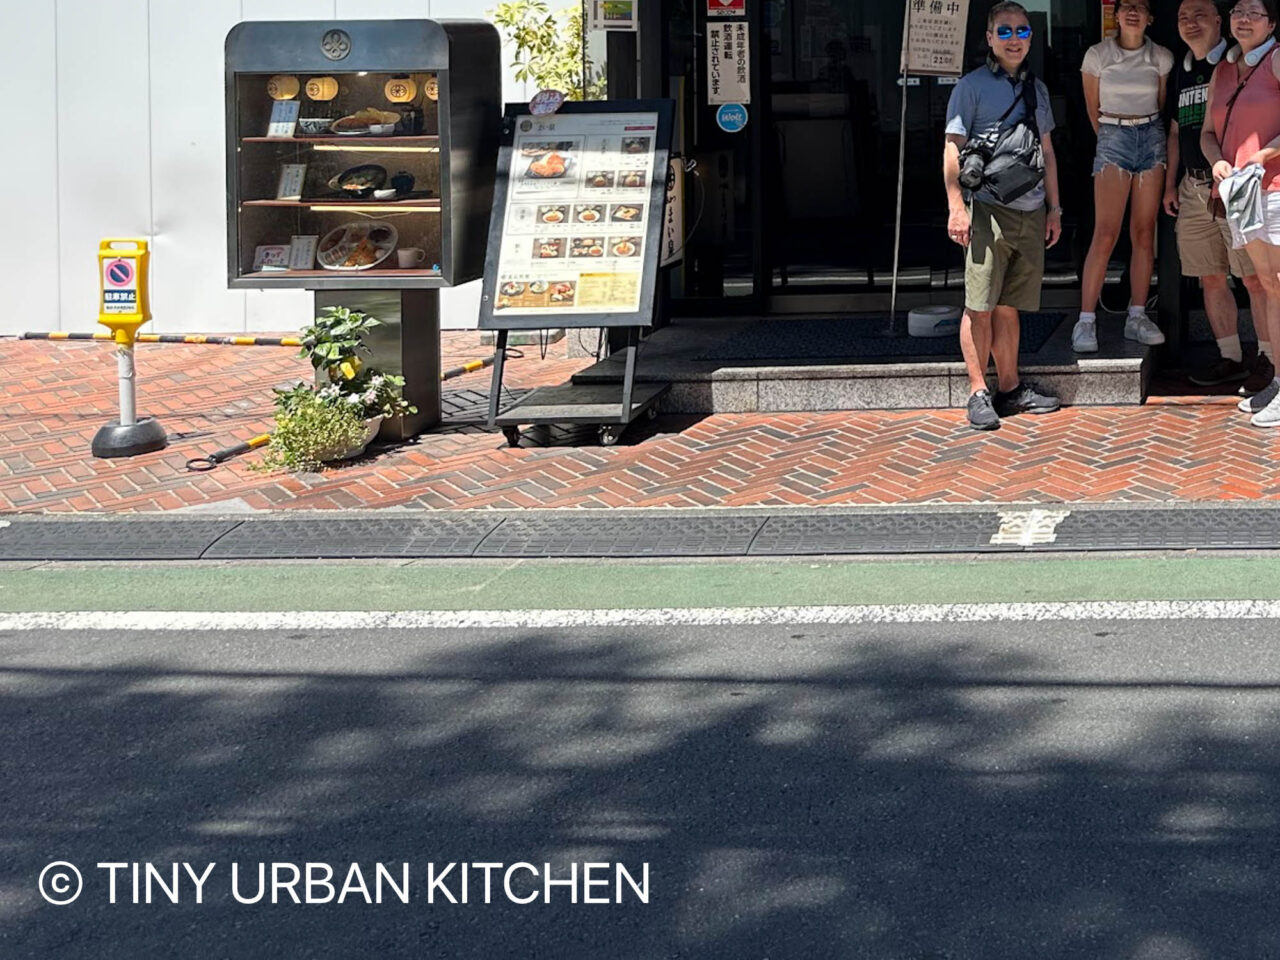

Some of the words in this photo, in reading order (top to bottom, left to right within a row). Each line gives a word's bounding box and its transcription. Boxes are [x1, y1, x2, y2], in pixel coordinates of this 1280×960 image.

[723, 23, 733, 60] 飲酒運転
[736, 23, 746, 84] 未成年者の飲酒
[721, 112, 743, 122] Wolt
[105, 292, 136, 301] 駐車禁止
